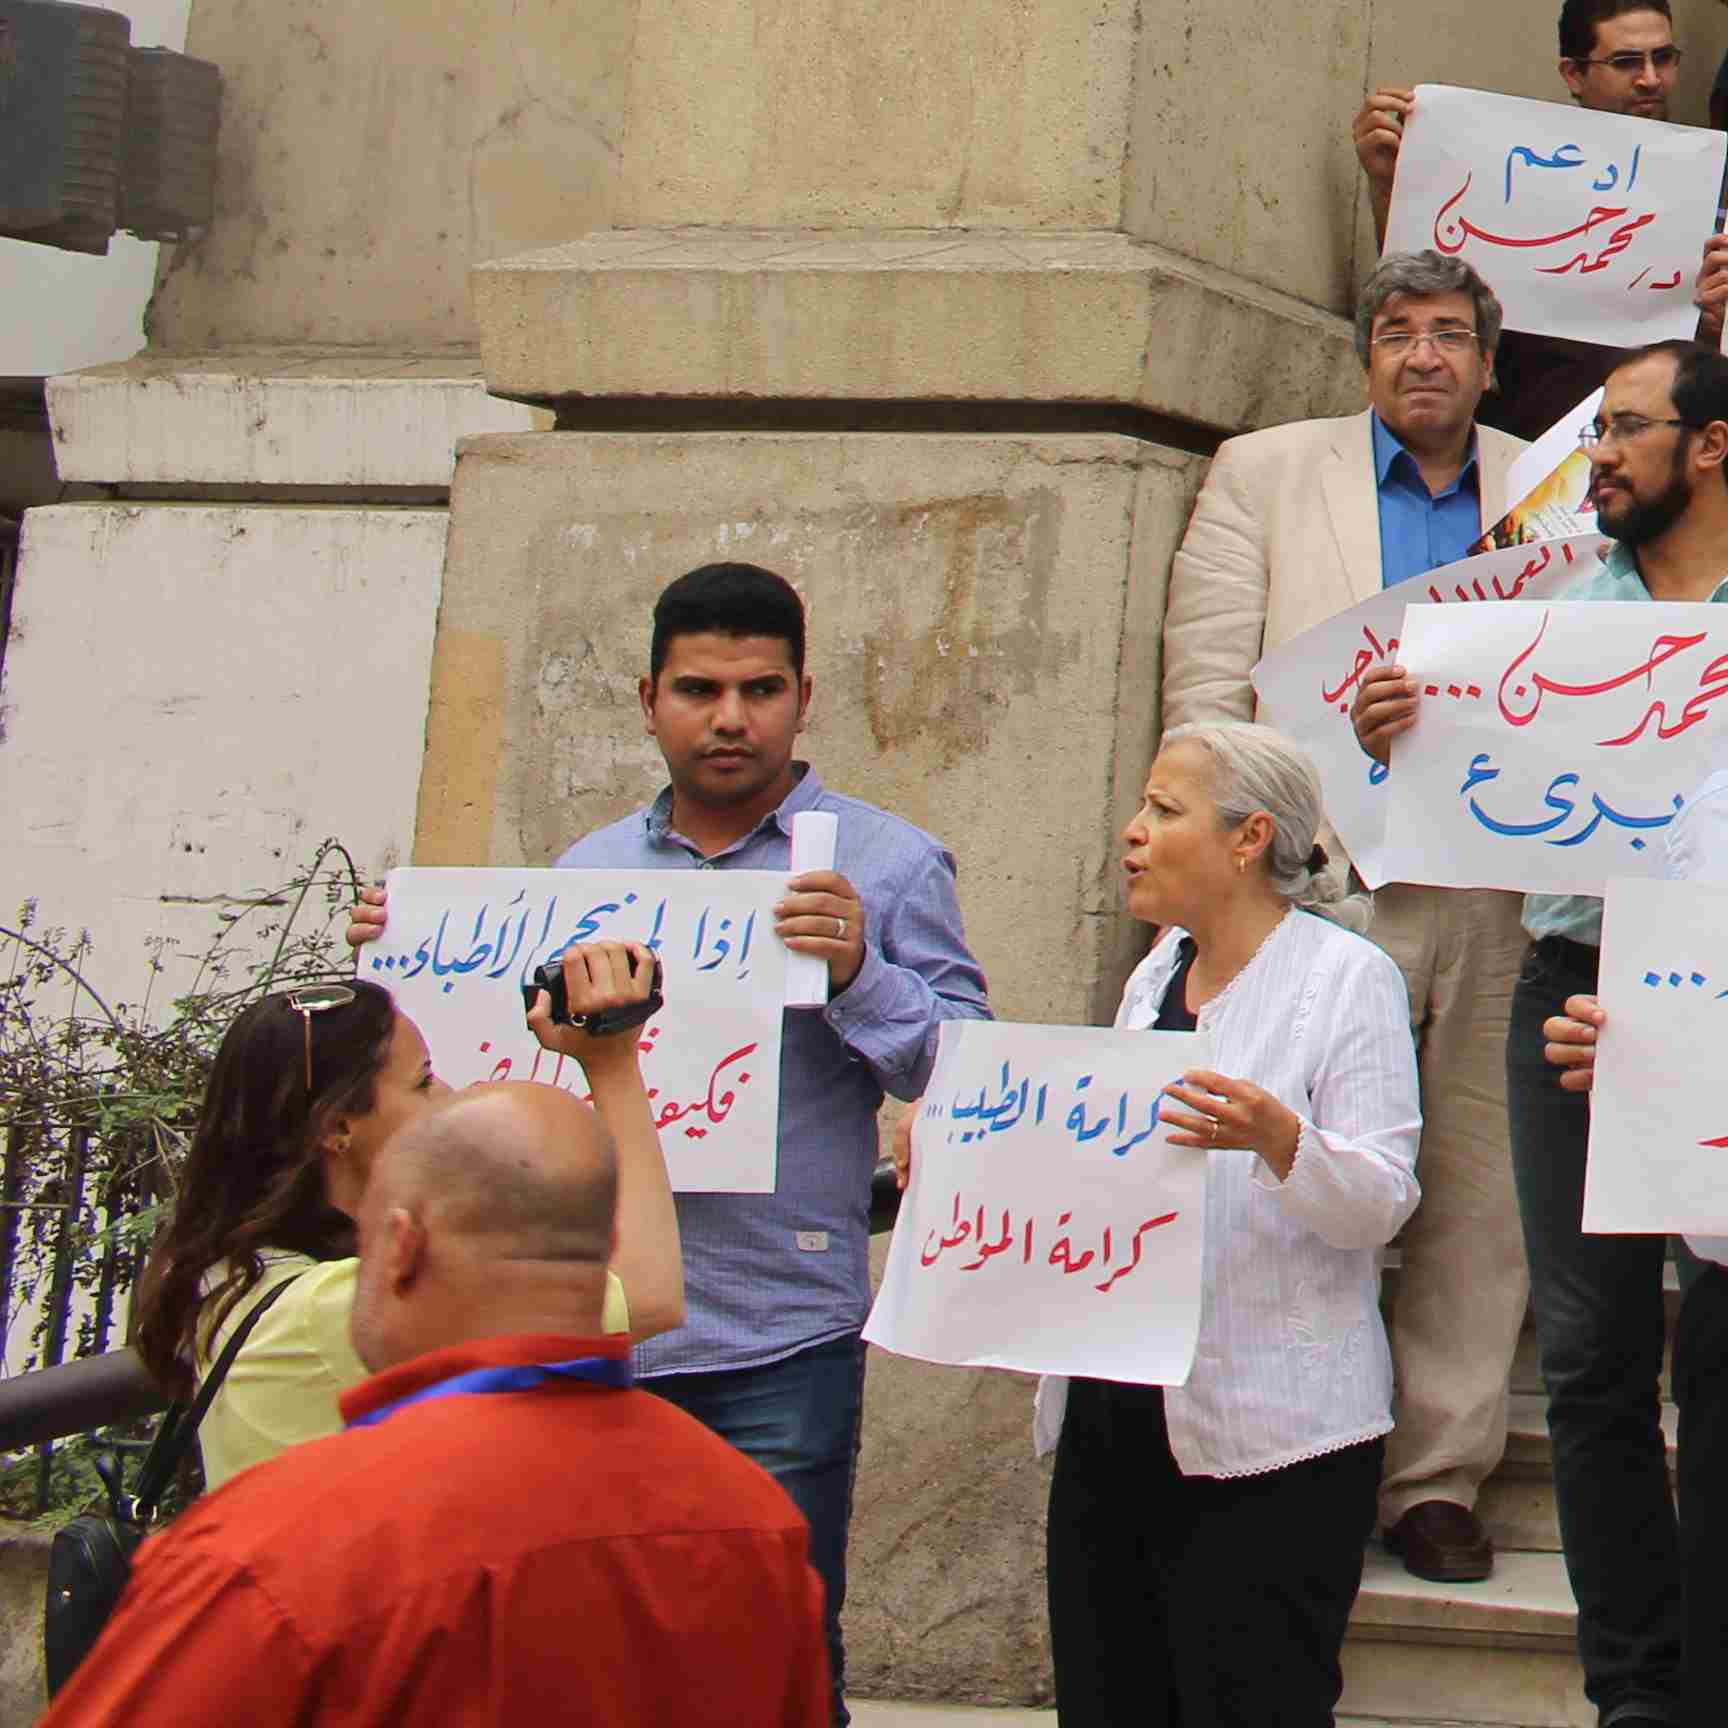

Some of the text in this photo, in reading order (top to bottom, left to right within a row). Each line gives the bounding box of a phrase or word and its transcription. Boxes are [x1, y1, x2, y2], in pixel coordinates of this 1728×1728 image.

[1505, 143, 1642, 202] ادعم
[1434, 170, 1628, 254] حسن
[1536, 214, 1655, 273] محمد
[693, 906, 756, 980] إذا
[1049, 1211, 1179, 1292] كرامة
